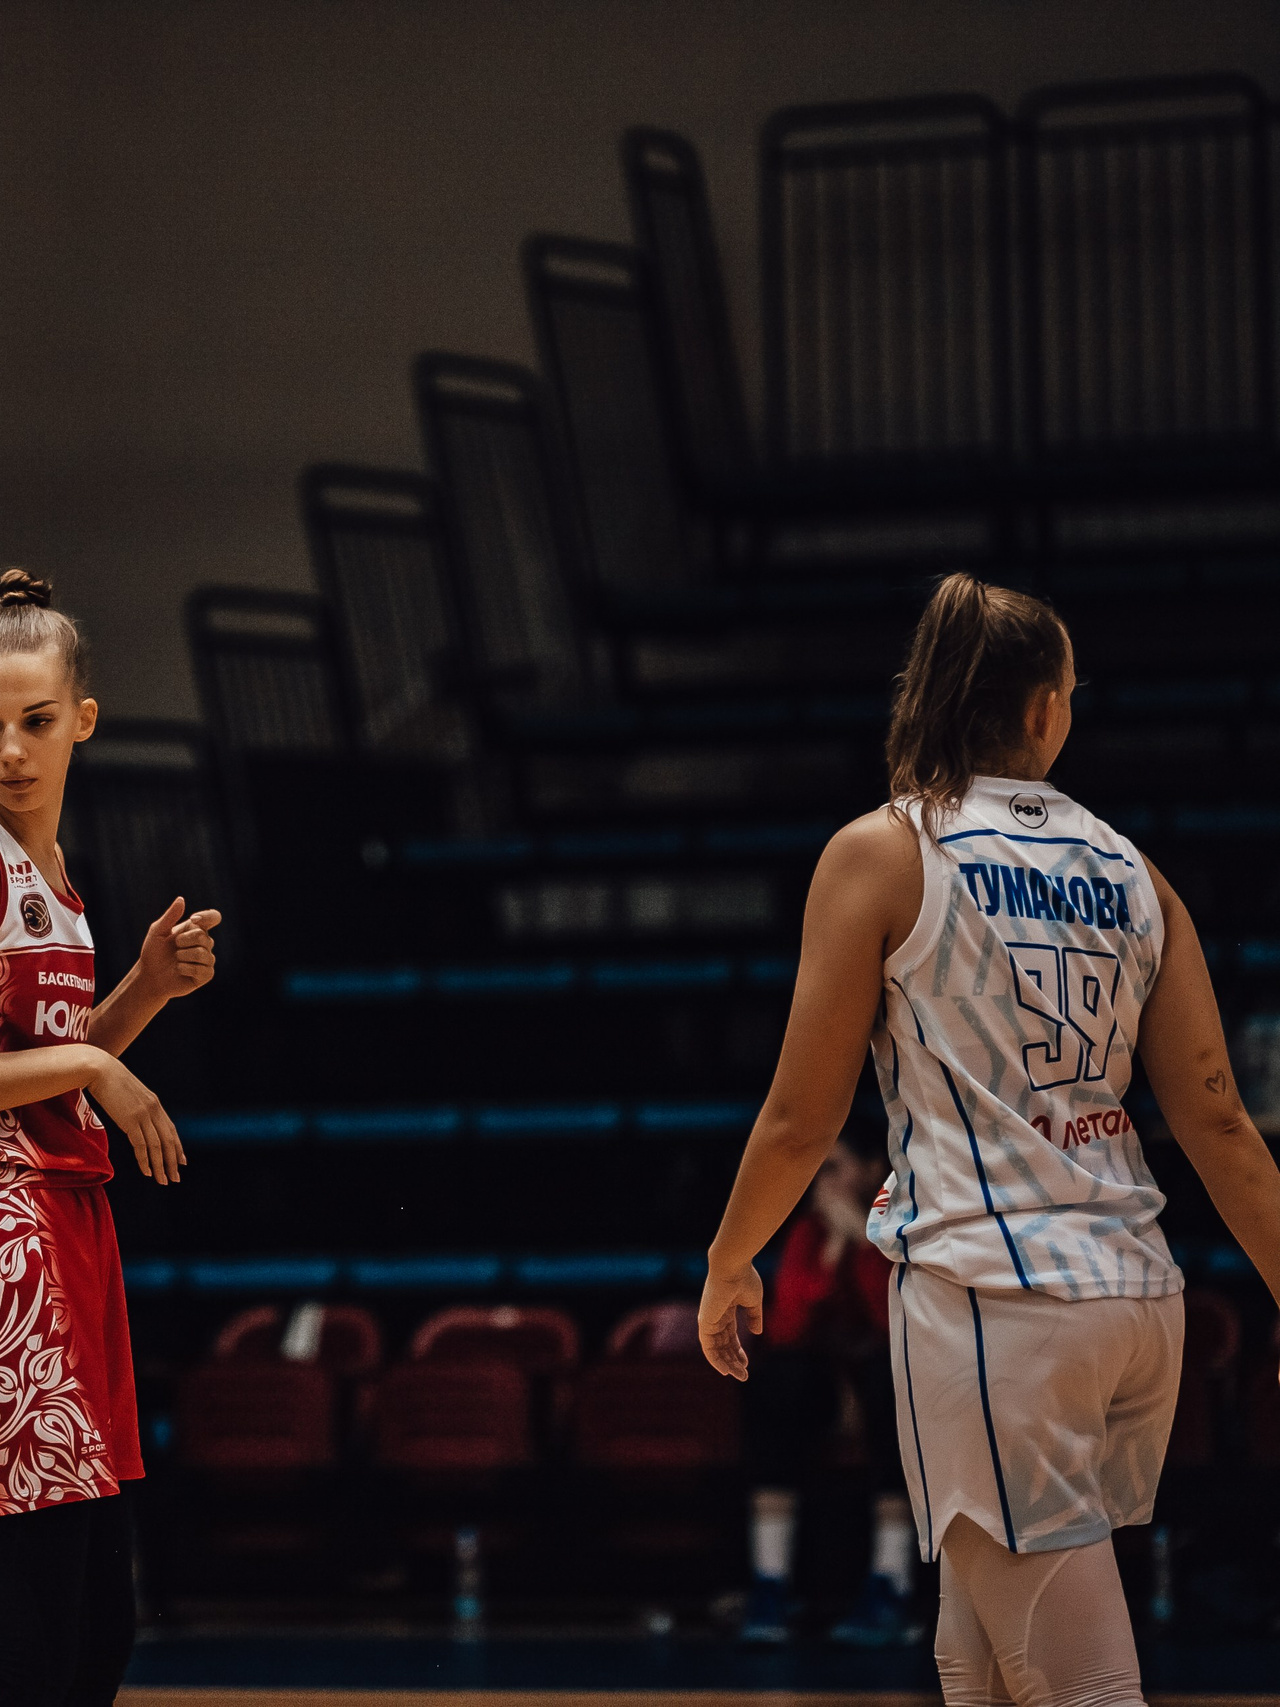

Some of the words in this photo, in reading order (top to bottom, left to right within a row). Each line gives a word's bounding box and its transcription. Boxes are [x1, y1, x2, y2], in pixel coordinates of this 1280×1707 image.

[1014, 804, 1044, 817] РФБ
[958, 862, 1136, 933] ТУМАНОВА
[1004, 941, 1122, 1092] 39
